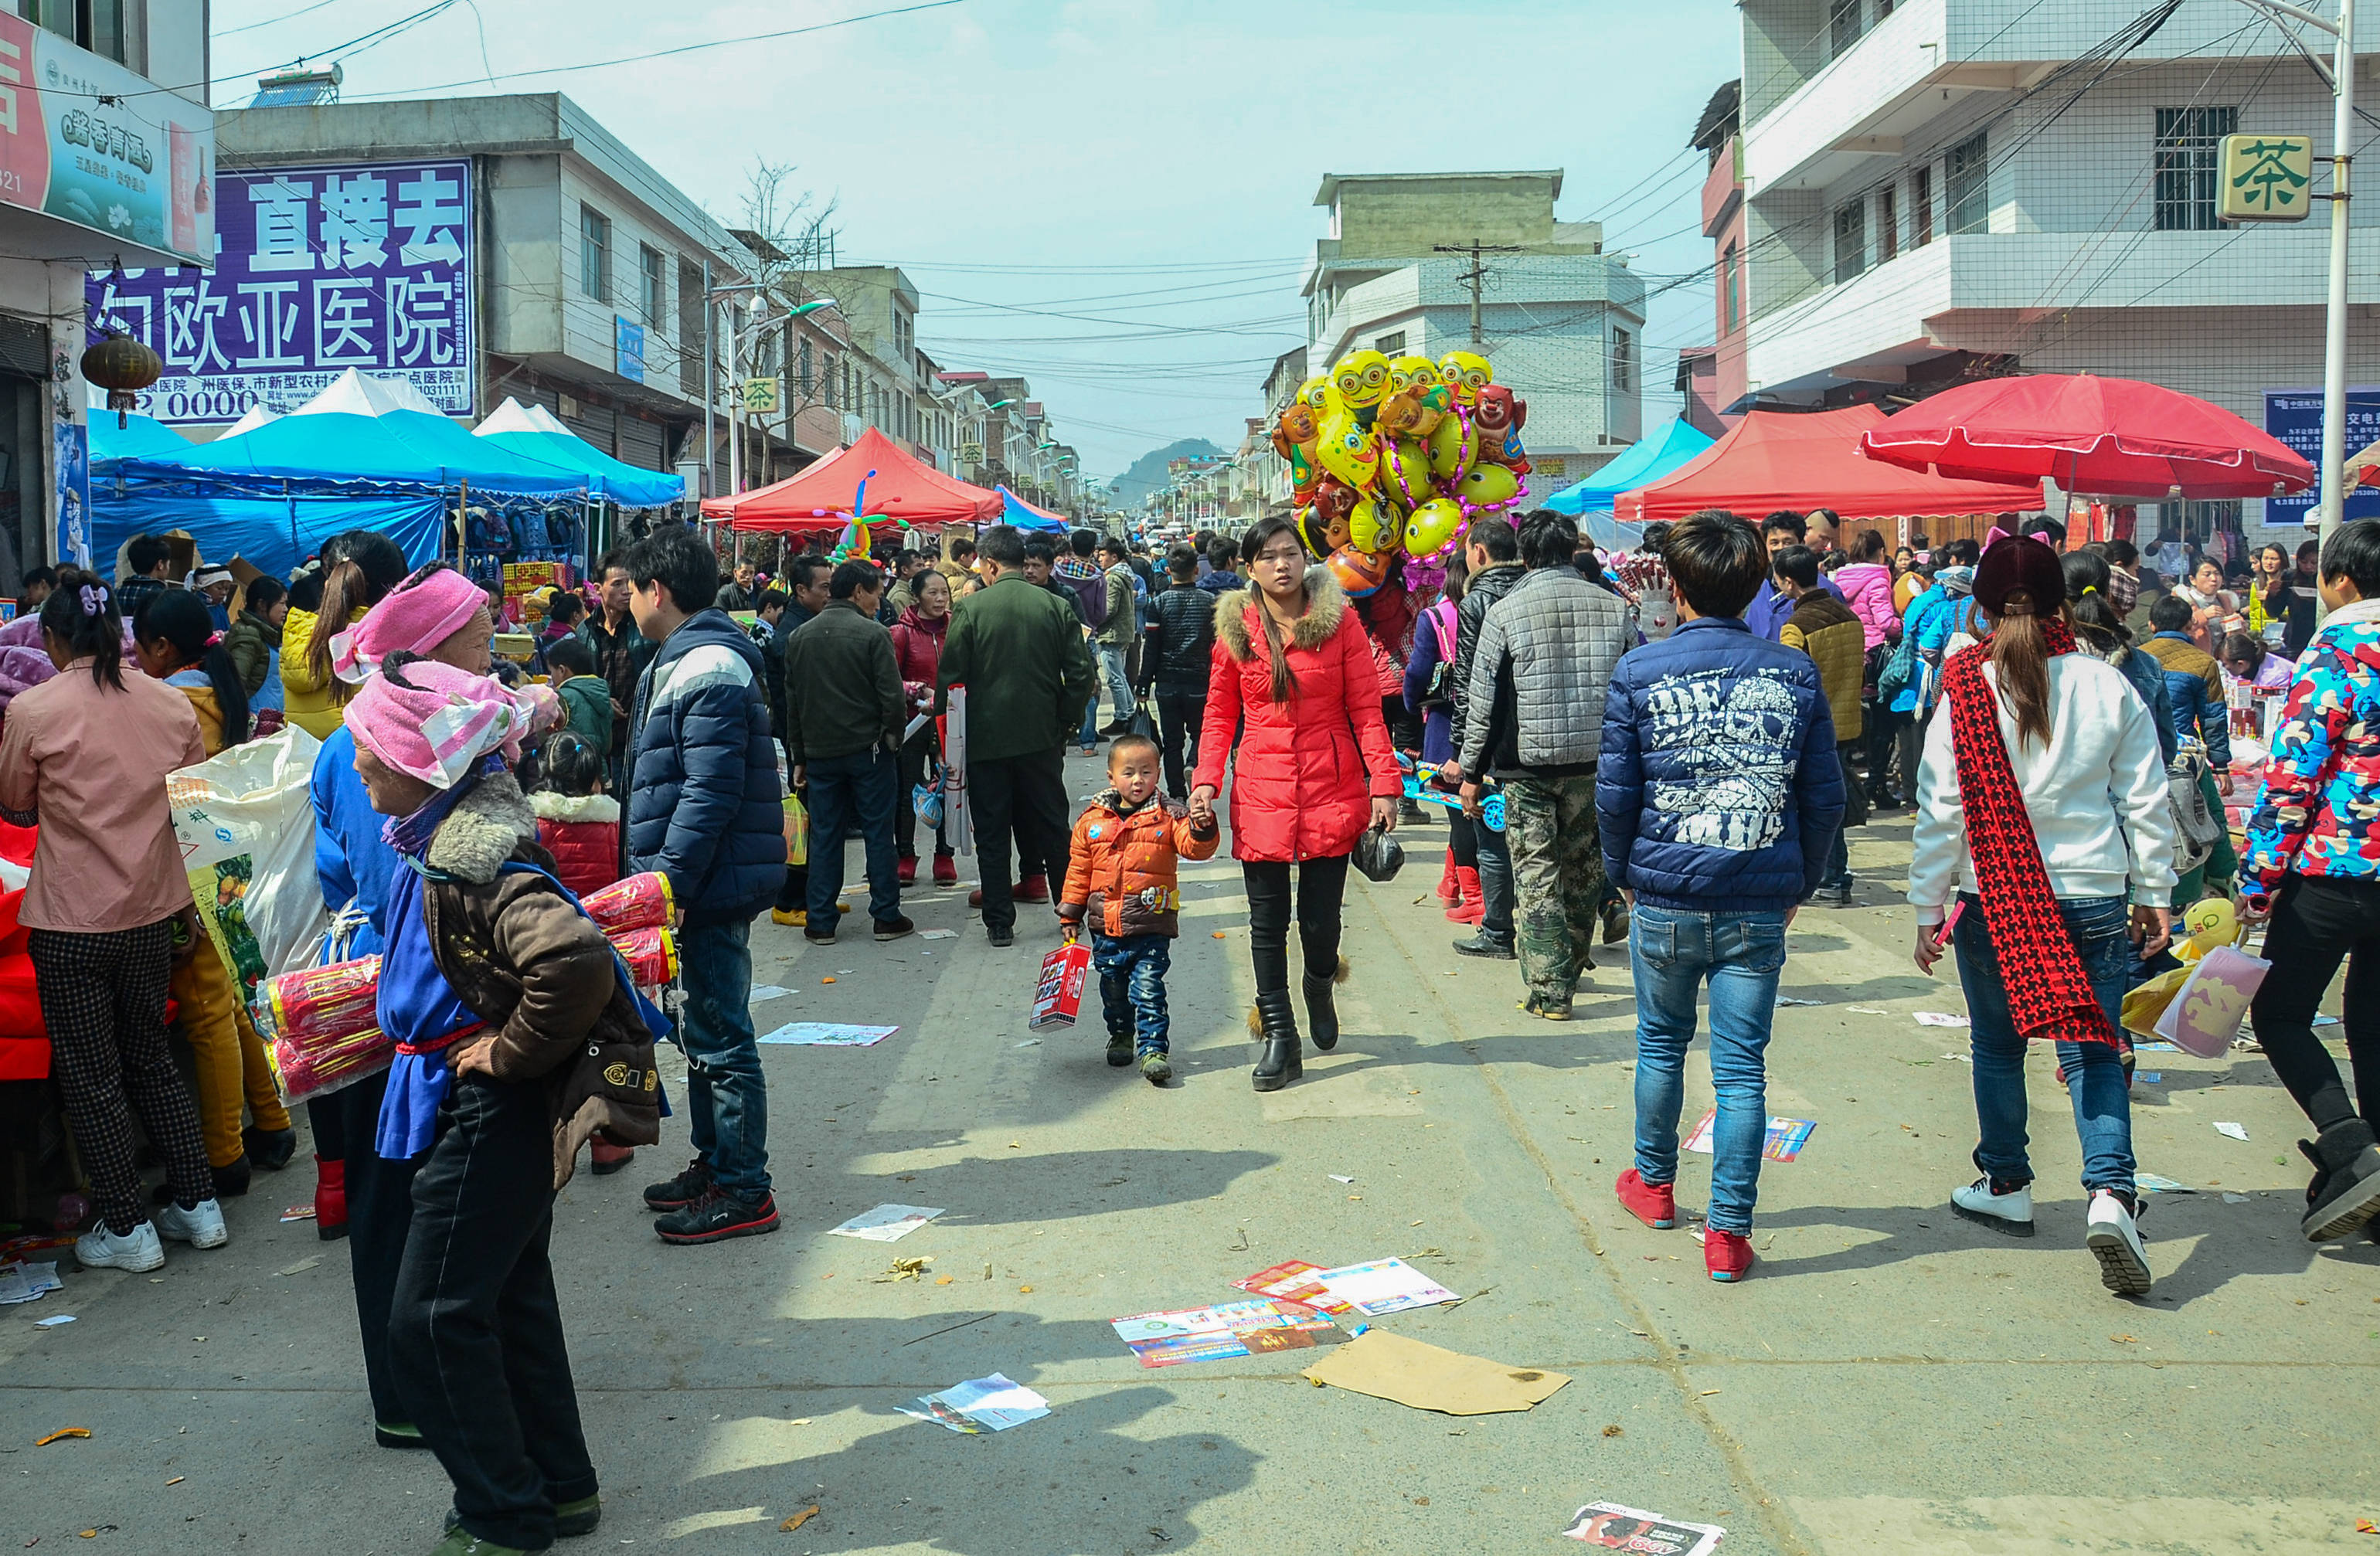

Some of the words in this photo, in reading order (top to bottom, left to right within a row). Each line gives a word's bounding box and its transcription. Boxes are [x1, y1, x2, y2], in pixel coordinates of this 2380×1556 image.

[2232, 140, 2310, 211] 茶
[248, 170, 464, 272] 直接去
[746, 381, 774, 410] 茶
[964, 445, 981, 461] 茶
